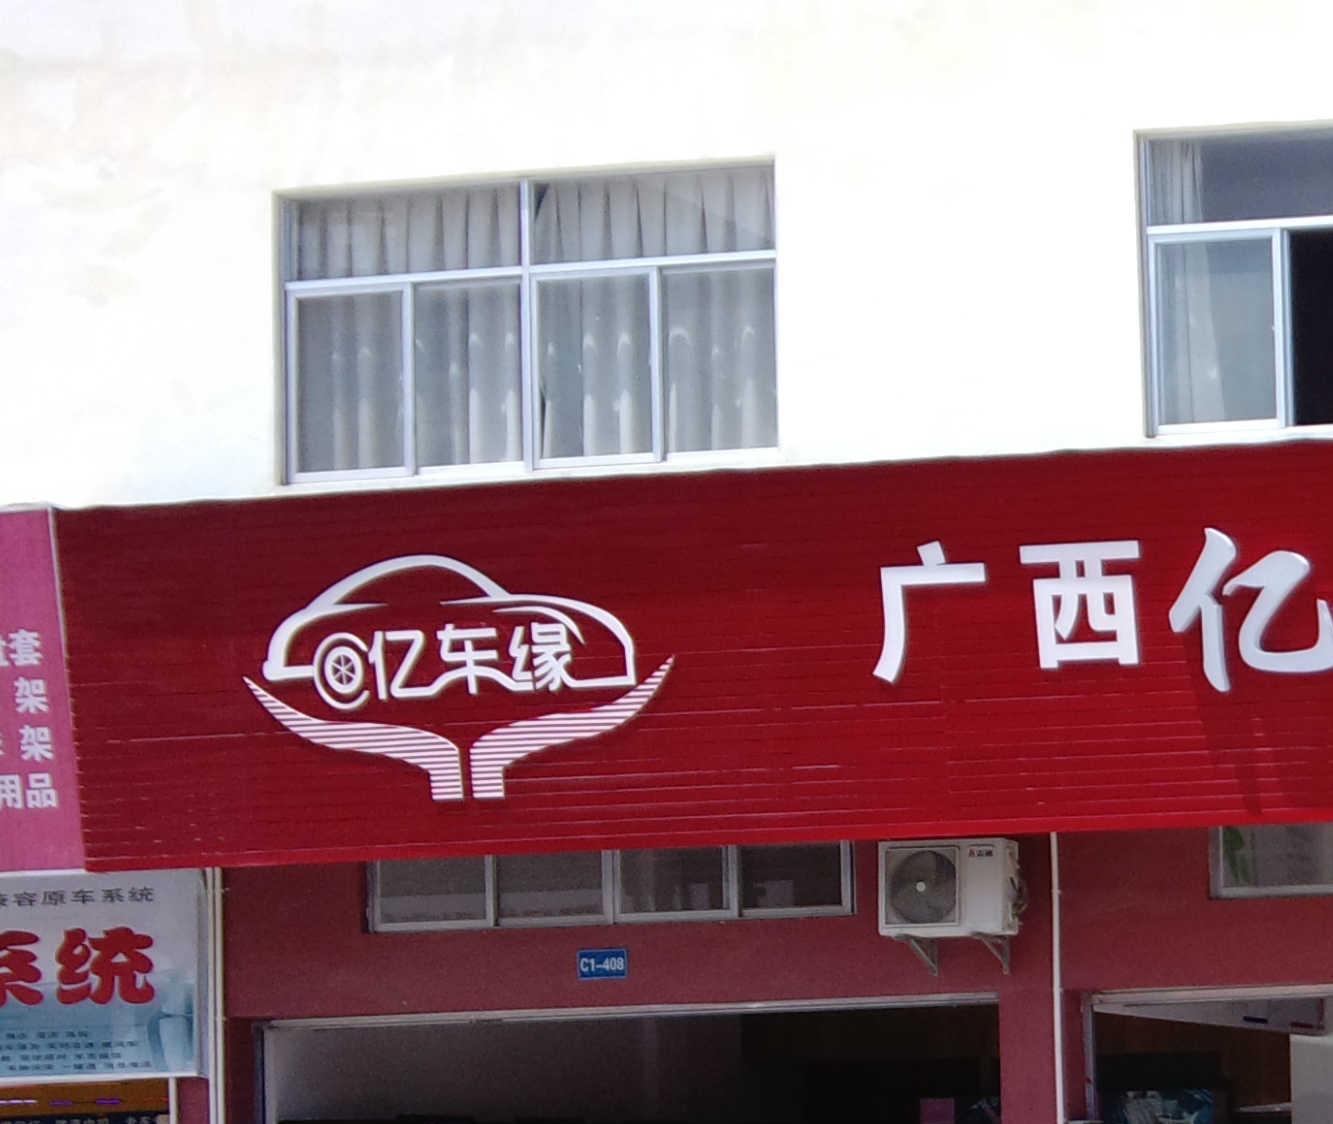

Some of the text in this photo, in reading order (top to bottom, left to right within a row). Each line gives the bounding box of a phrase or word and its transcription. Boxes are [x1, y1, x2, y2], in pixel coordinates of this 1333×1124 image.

[368, 622, 572, 700] 亿车缘
[14, 677, 48, 714] 架
[19, 725, 54, 762] 架
[580, 957, 625, 972] C1-408
